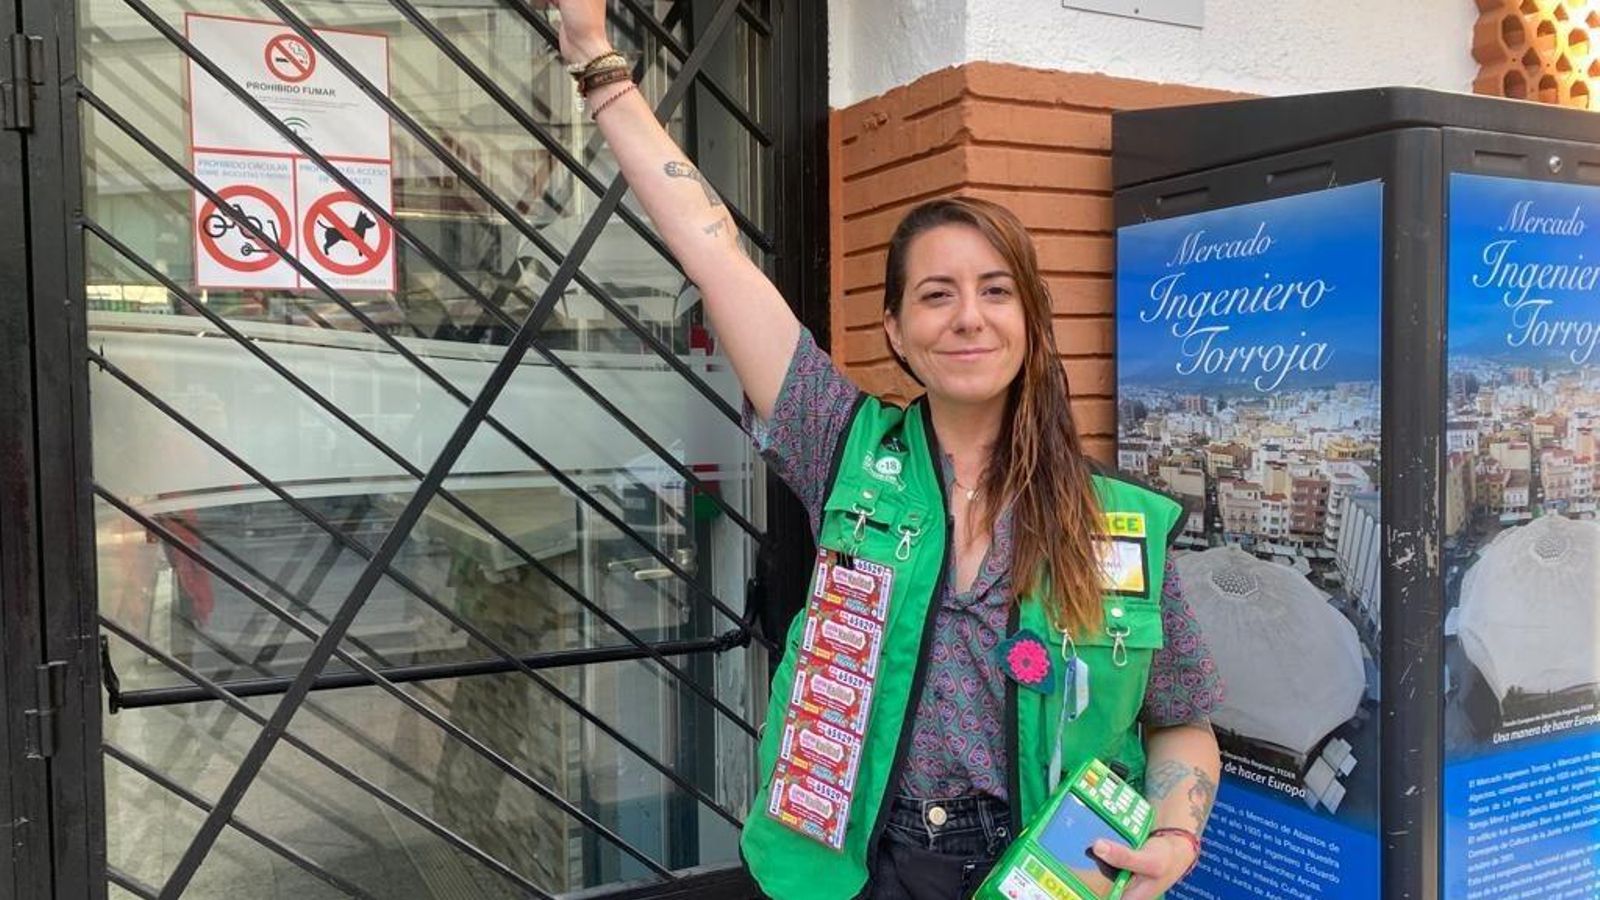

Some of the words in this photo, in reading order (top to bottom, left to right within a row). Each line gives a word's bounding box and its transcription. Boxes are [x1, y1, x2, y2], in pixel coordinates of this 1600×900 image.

[246, 82, 299, 94] PROHIBIDO
[302, 84, 336, 96] FUMAR
[1499, 200, 1587, 236] Mercado
[1166, 222, 1275, 268] Mercado
[1140, 272, 1335, 337] Ingeniero
[1176, 326, 1334, 392] Torroja
[1111, 517, 1139, 532] CE
[1493, 731, 1509, 742] Una
[1510, 726, 1540, 739] manera
[1552, 717, 1573, 730] hacer
[1224, 761, 1236, 773] de
[1238, 766, 1266, 783] hacer
[1267, 775, 1306, 799] Europa
[1246, 811, 1278, 828] Mercado
[1282, 839, 1304, 854] Plaza
[1306, 849, 1340, 868] Nuestra
[1304, 863, 1340, 883] Eduardo
